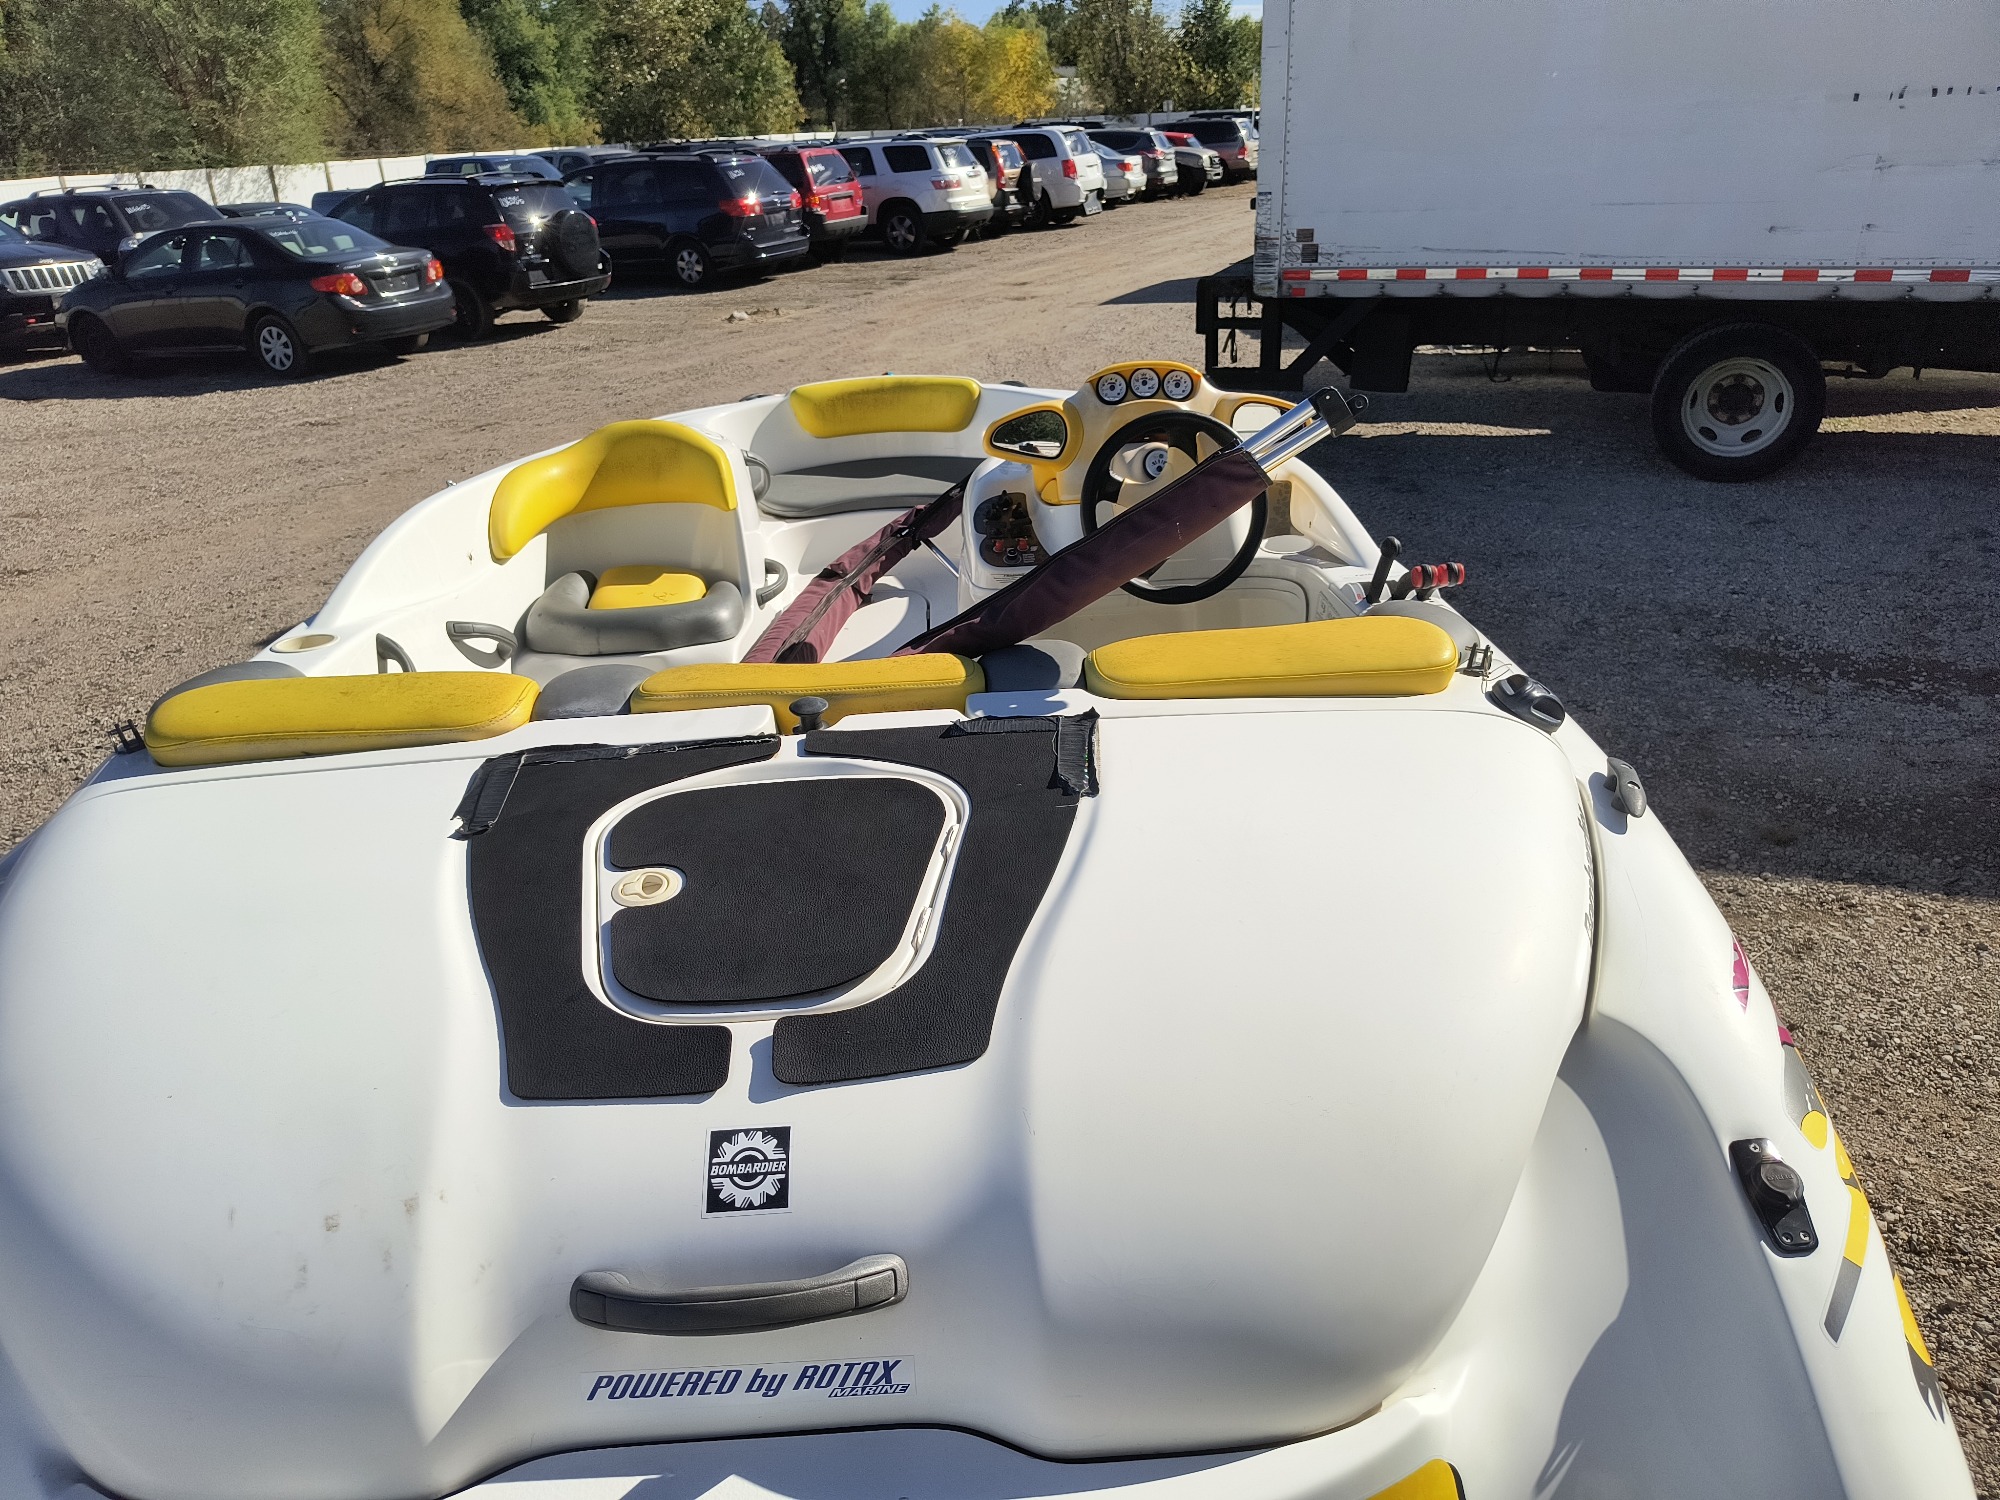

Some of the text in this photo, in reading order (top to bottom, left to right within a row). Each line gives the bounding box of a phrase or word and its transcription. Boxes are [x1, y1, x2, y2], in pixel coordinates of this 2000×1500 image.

[710, 1161, 787, 1176] BOMBARDIER
[587, 1360, 903, 1401] POWERED by ROTAX
[829, 1384, 910, 1398] MARINE
